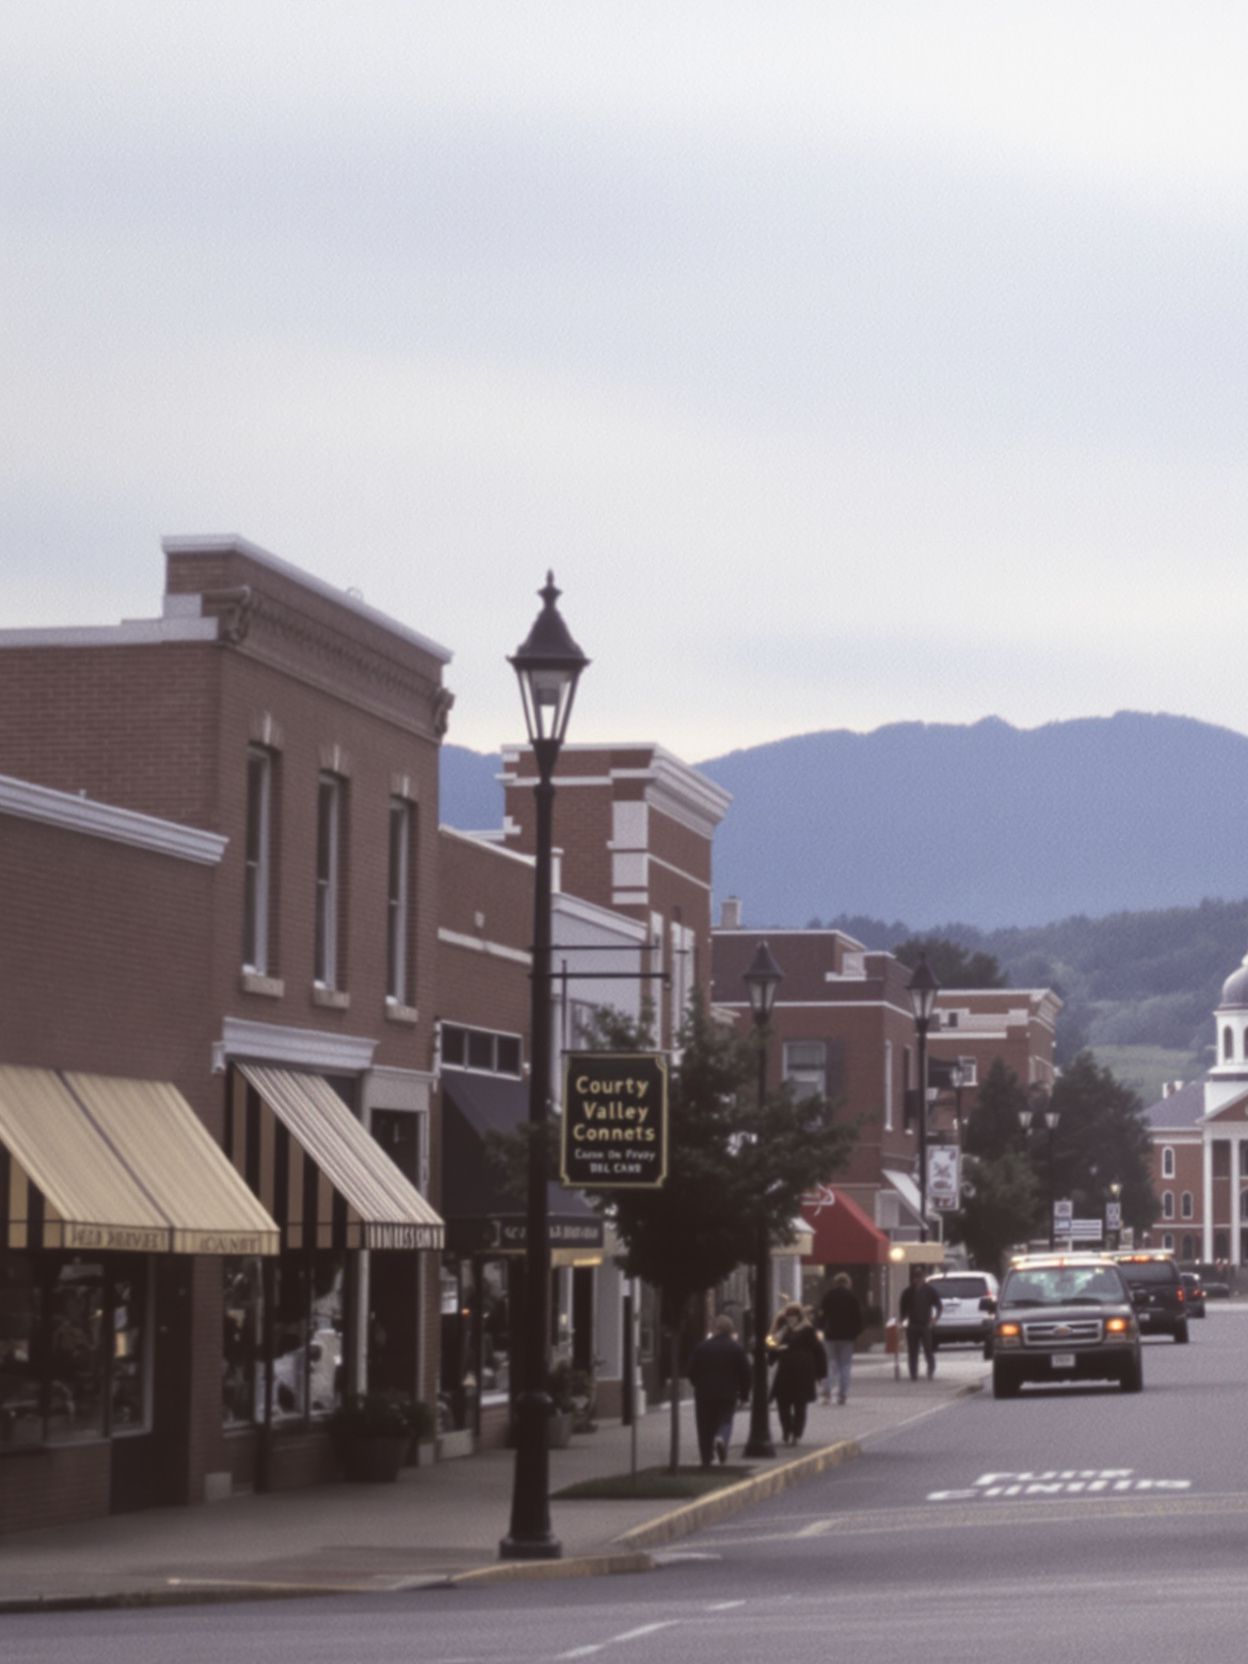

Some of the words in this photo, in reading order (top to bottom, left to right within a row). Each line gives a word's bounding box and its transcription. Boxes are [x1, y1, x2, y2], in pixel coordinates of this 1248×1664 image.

[576, 1075, 648, 1098] Courty
[583, 1101, 648, 1123] Valley
[573, 1123, 655, 1141] Connets
